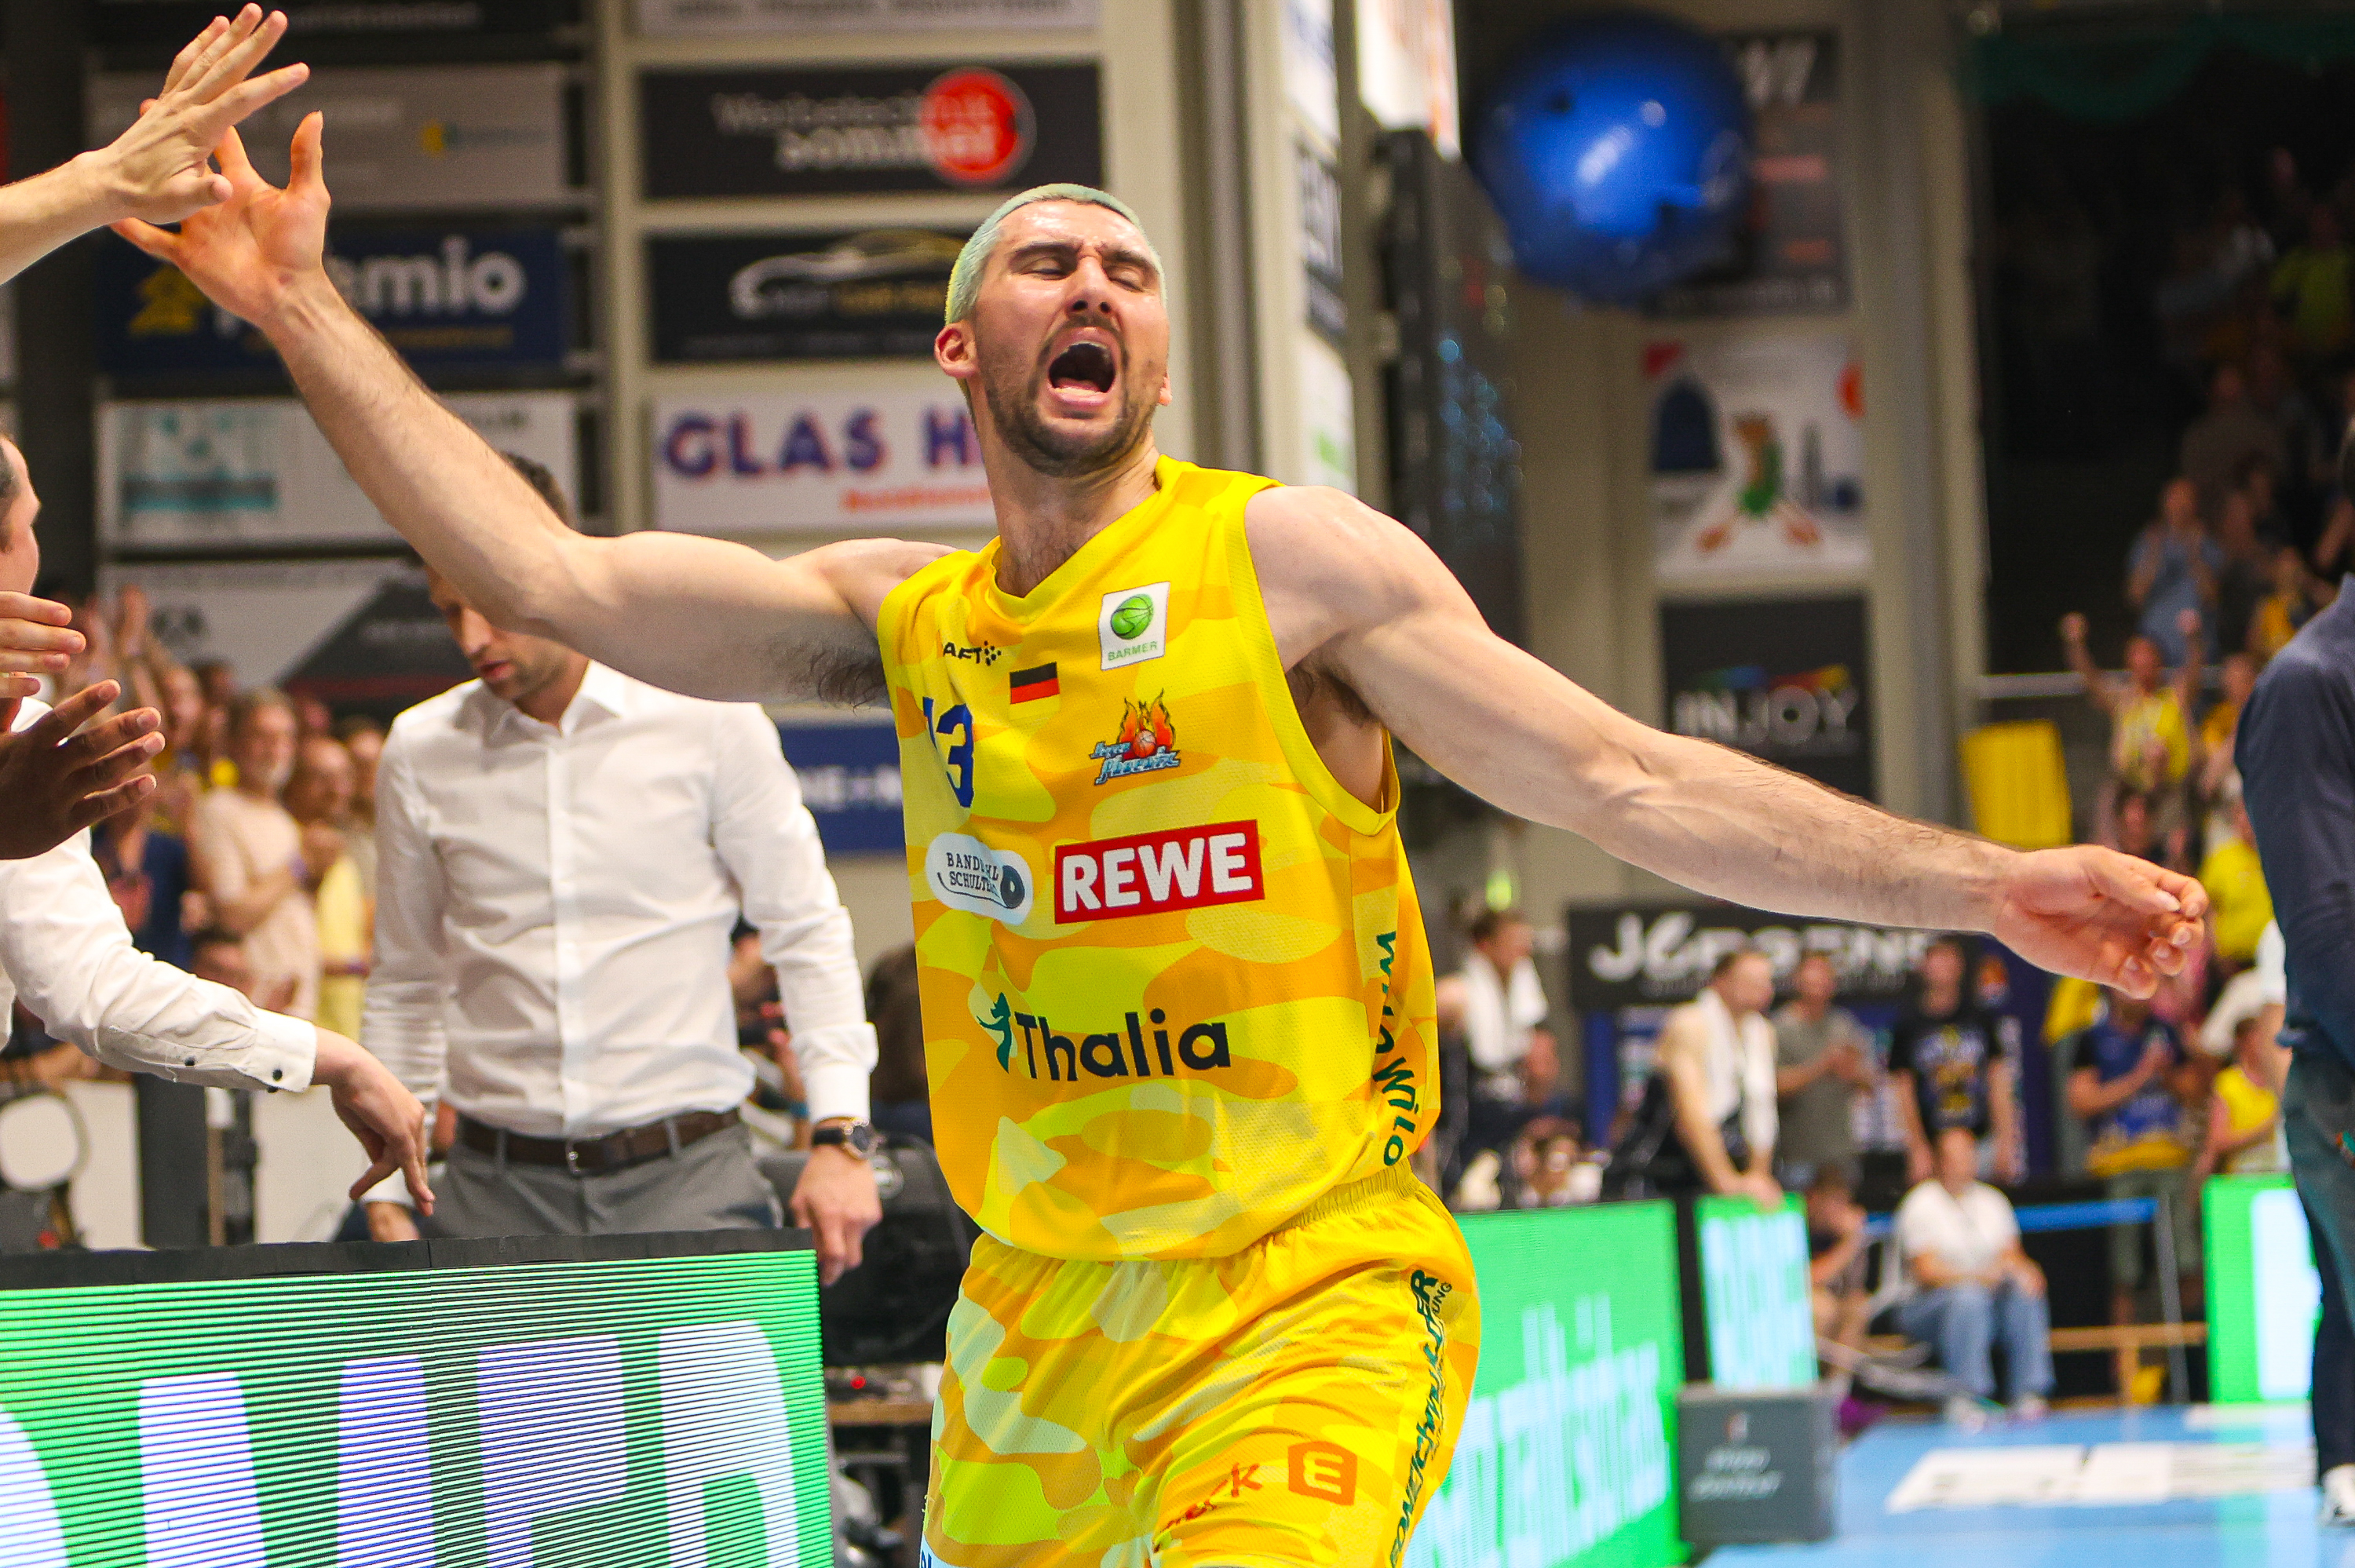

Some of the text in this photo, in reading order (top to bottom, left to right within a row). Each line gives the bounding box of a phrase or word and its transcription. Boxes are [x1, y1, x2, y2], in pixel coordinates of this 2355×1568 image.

[661, 410, 887, 479] GLAS
[1108, 641, 1159, 661] BARMER
[1063, 833, 1253, 913] REWE
[1014, 1008, 1231, 1081] Thalia
